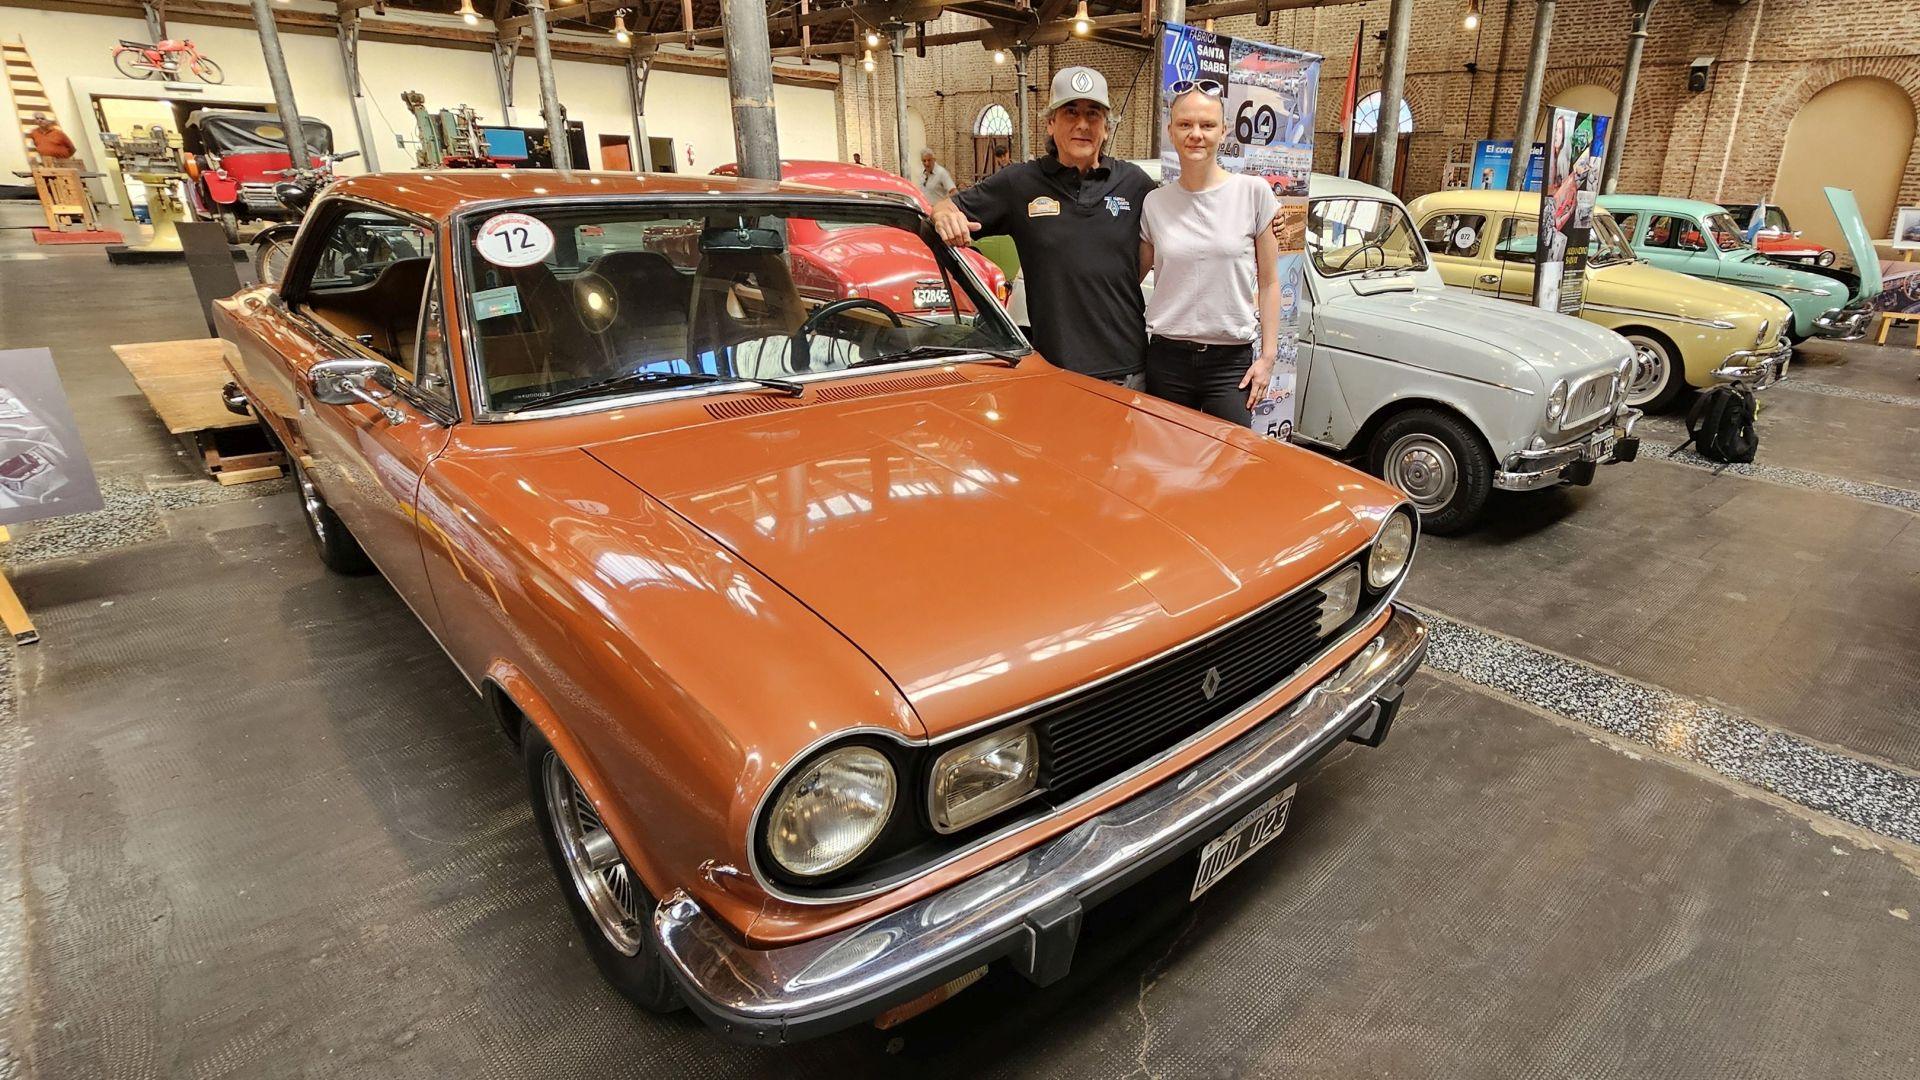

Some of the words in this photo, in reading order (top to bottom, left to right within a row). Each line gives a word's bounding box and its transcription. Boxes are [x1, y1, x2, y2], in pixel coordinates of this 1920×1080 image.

[1196, 45, 1225, 60] SANTA
[1200, 59, 1229, 74] ISABEL
[1235, 100, 1277, 146] 60
[494, 227, 536, 253] 72
[1267, 420, 1293, 442] 50
[1232, 802, 1271, 832] ARGENTINA
[1250, 800, 1289, 847] 023
